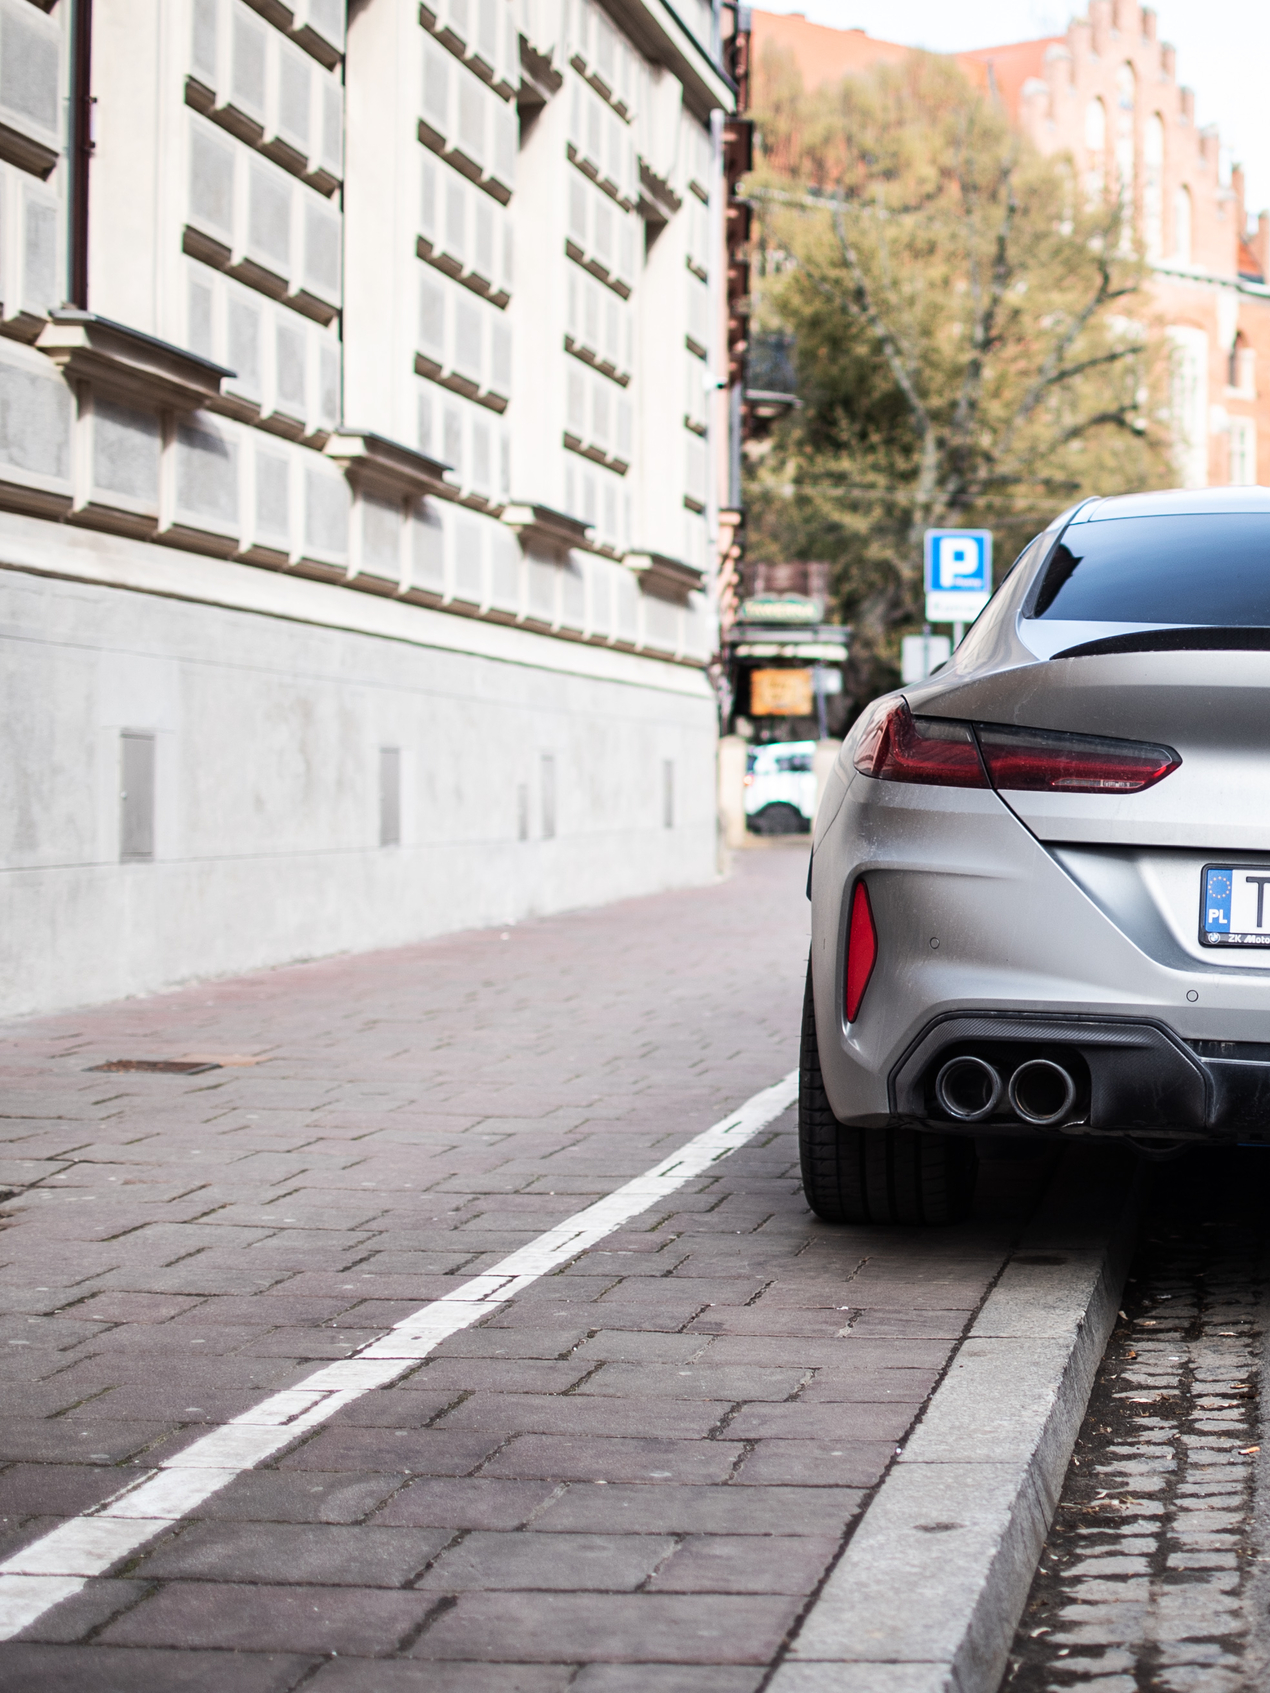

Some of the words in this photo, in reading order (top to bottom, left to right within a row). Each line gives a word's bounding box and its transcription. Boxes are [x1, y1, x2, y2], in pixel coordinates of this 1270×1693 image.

[939, 537, 979, 587] P
[1207, 908, 1228, 924] PL
[1228, 934, 1242, 943] ZK
